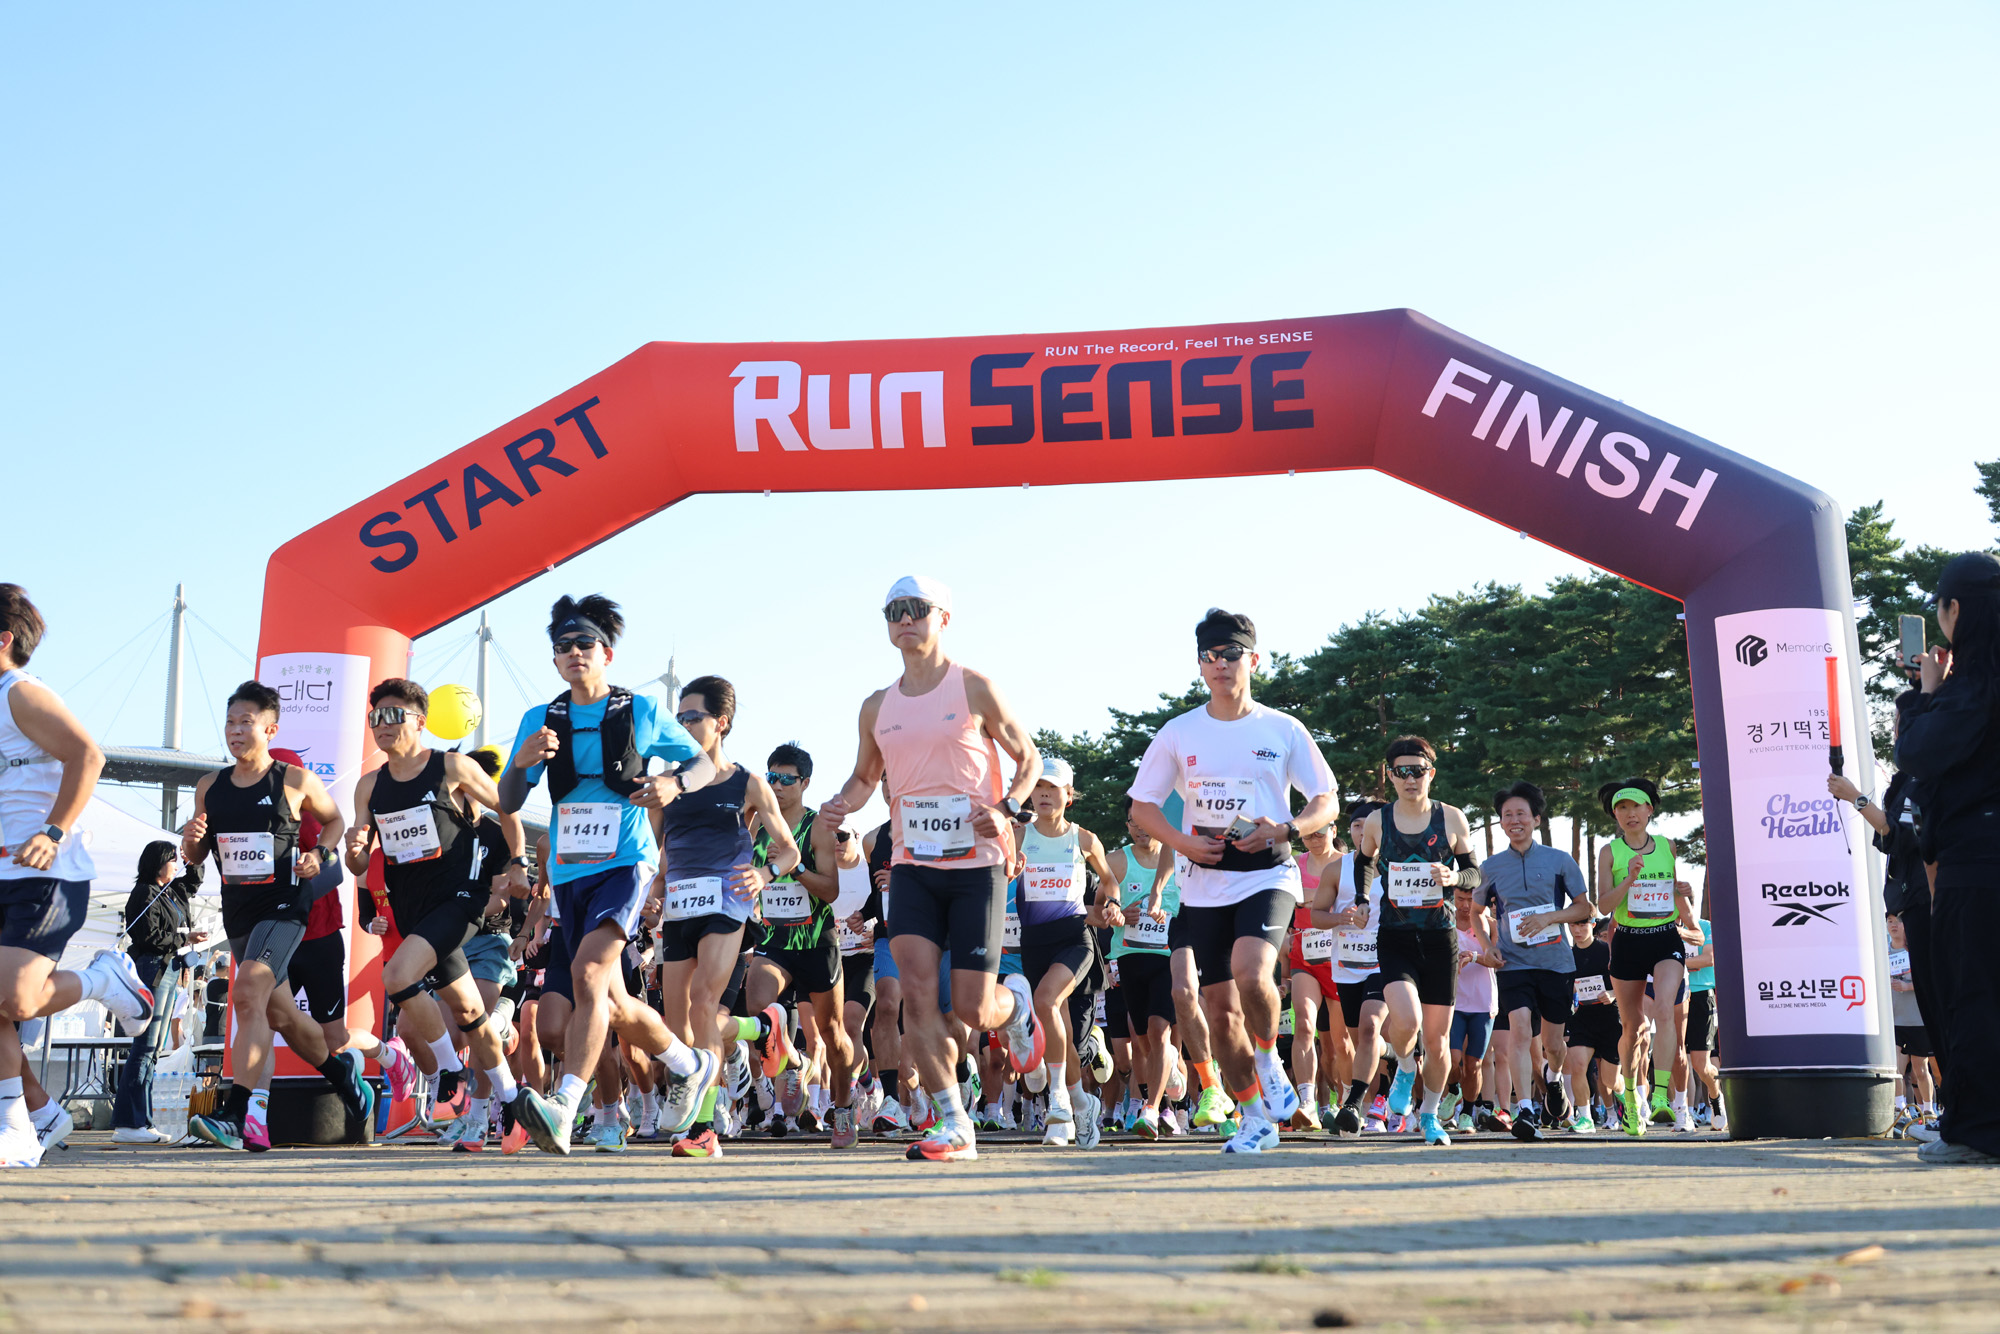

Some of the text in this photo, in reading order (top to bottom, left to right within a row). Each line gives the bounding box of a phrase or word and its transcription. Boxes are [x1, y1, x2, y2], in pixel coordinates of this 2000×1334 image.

[1045, 331, 1313, 357] RUN The Record, Feel The SENSE
[729, 361, 946, 452] Run
[1421, 357, 1719, 531] FINISH
[359, 395, 609, 574] START
[1776, 642, 1833, 653] MemorinG
[281, 704, 329, 714] addy food
[1749, 744, 1783, 754] KYUNGGI
[1196, 799, 1247, 810] M 1057
[1766, 794, 1834, 816] Choco
[563, 823, 610, 836] M 1411
[909, 817, 961, 832] M 1061
[1761, 811, 1841, 838] Health
[385, 824, 428, 841] M 1095
[233, 850, 266, 861] 1806
[1040, 878, 1072, 888] 2500
[1643, 893, 1669, 901] 2176
[1762, 881, 1849, 901] Reebok
[671, 895, 715, 909] M 1784
[776, 896, 803, 906] 1767
[1138, 922, 1165, 933] 1845
[1630, 924, 1667, 934] DESCENTE
[1351, 943, 1377, 951] 1538
[1758, 979, 1838, 1001] 일요신문
